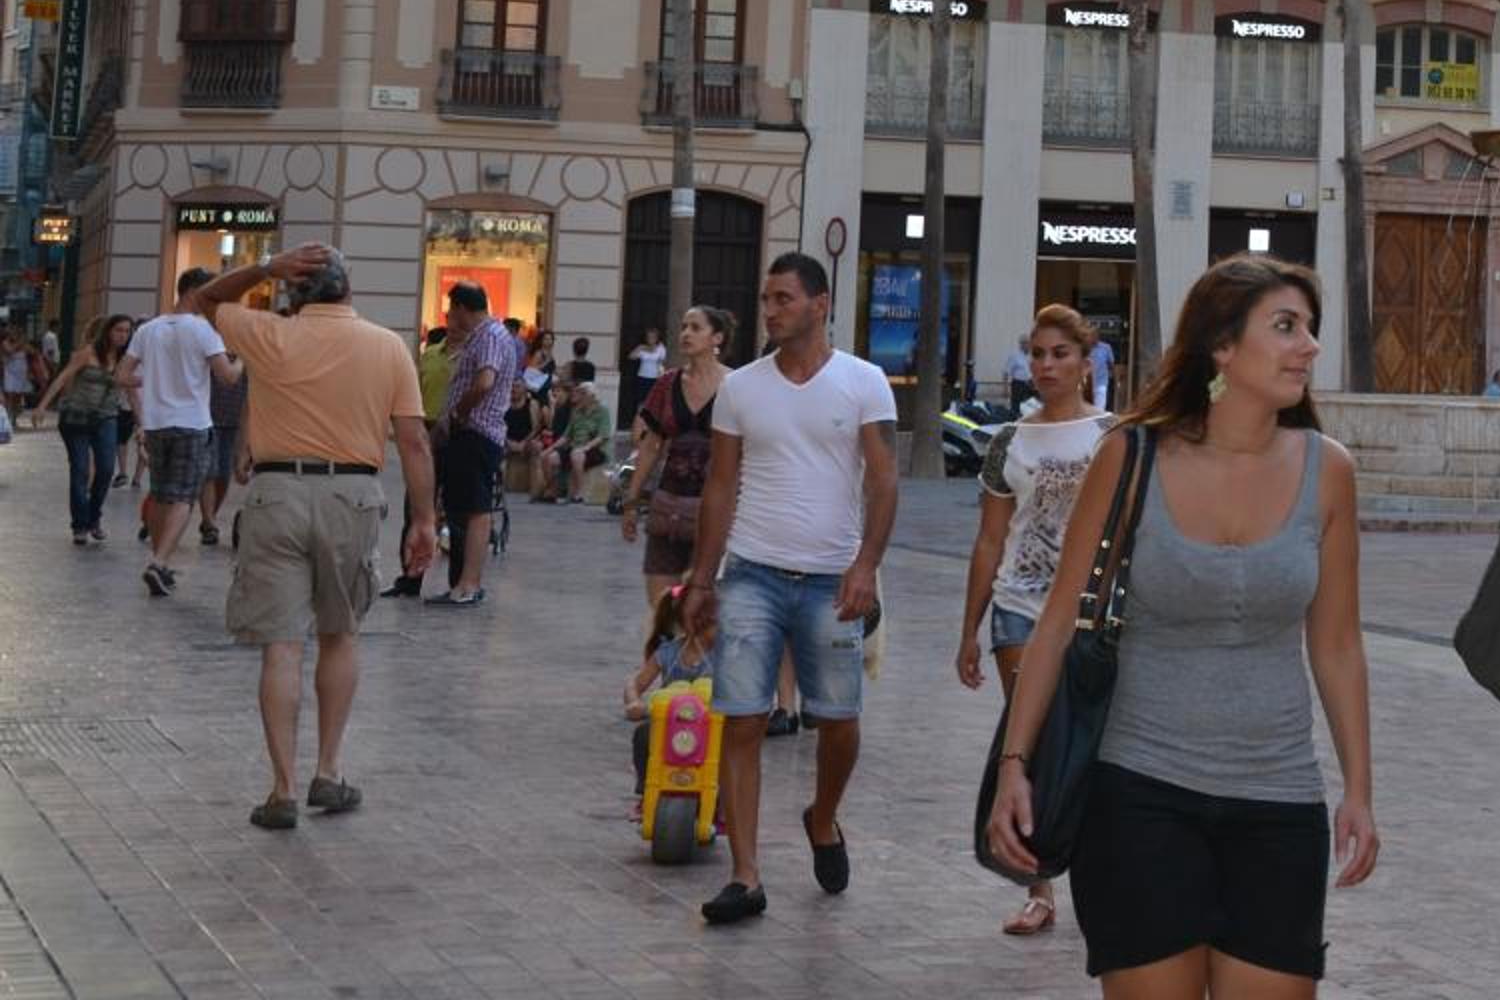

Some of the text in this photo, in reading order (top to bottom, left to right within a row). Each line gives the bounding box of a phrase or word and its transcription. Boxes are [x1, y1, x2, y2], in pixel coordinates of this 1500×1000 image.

[1064, 8, 1130, 27] NESPRESS
[1232, 19, 1305, 39] NESPRESSO
[61, 66, 77, 134] MARKET
[181, 209, 275, 222] PUNT ROMA
[497, 219, 543, 232] ROMA
